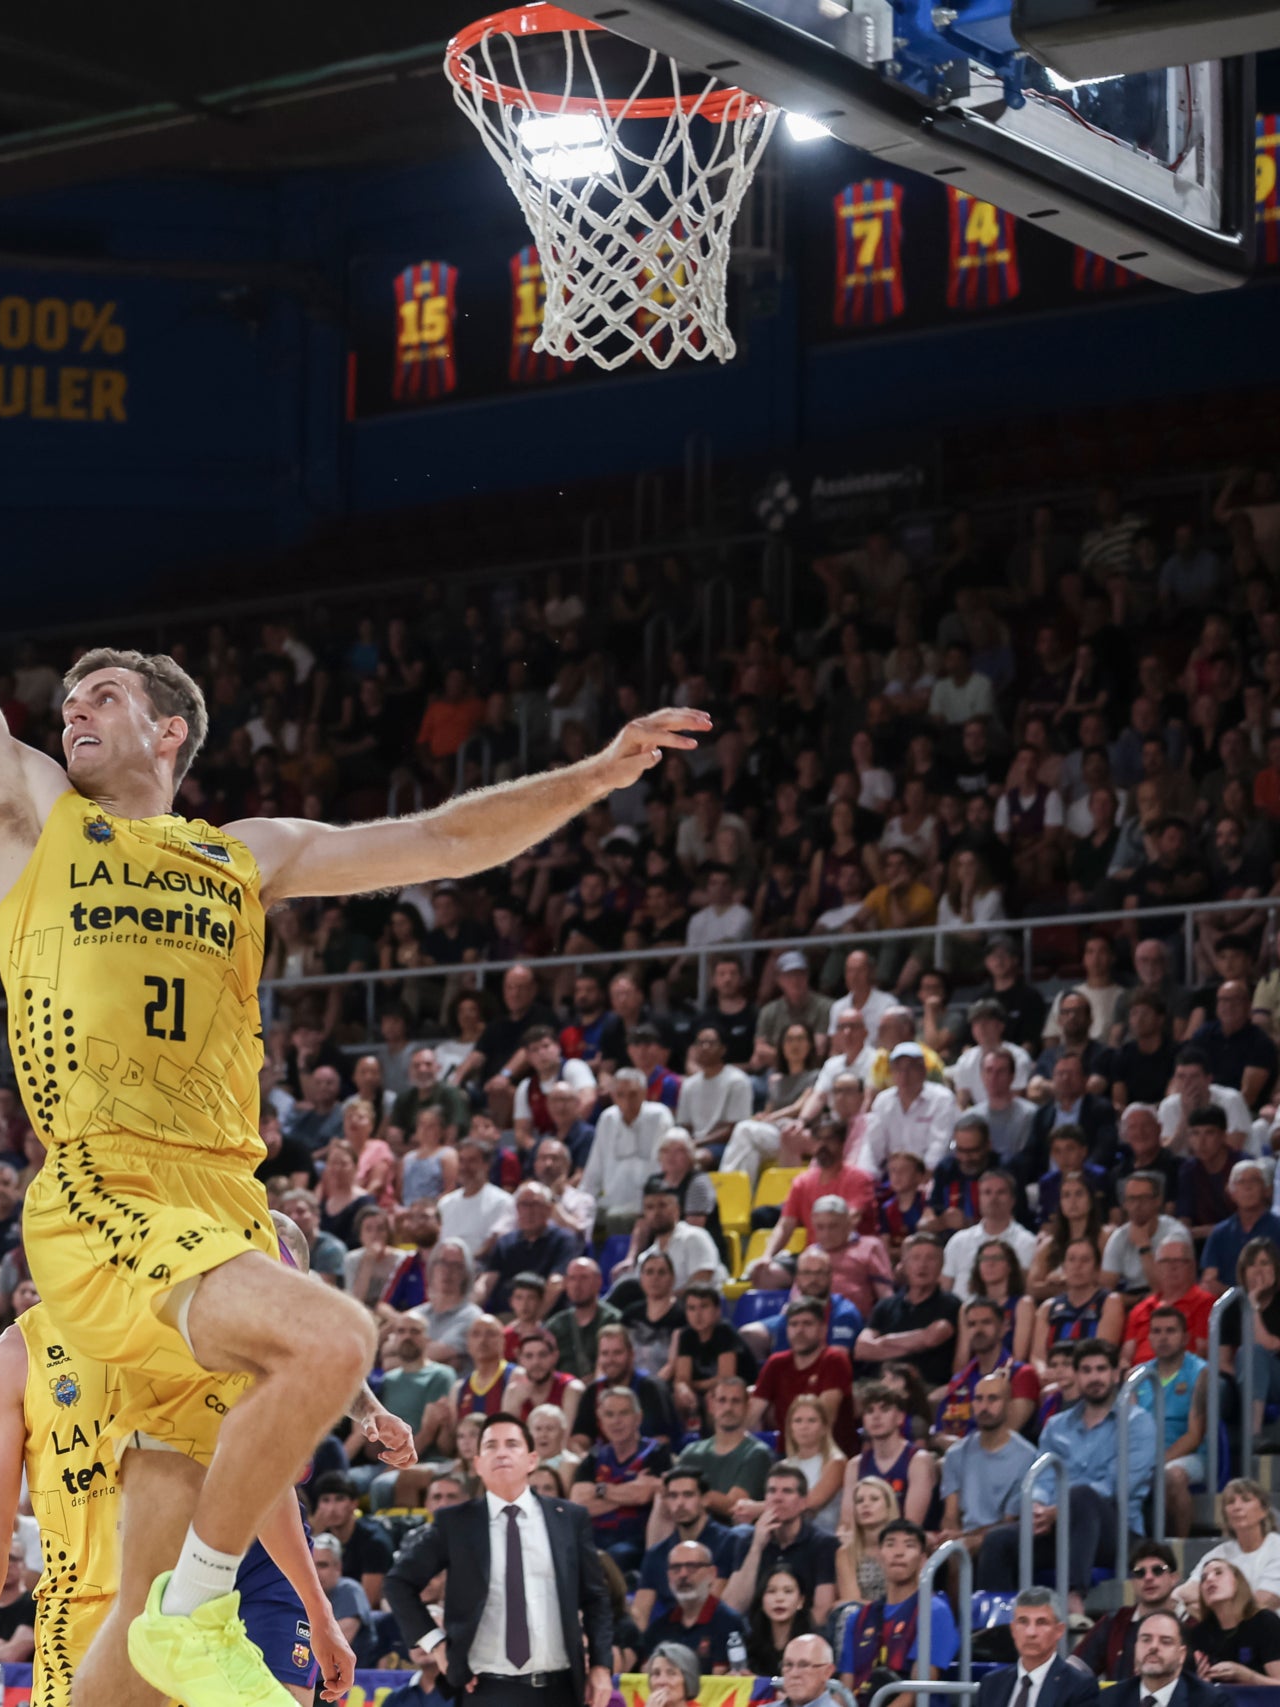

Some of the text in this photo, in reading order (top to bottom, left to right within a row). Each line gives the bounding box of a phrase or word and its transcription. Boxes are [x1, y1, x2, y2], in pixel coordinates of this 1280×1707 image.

[852, 218, 883, 267] 7
[965, 201, 1000, 247] 4
[400, 296, 448, 346] 15
[70, 860, 242, 916] LA LAGUNA
[73, 932, 148, 946] despierta
[144, 975, 186, 1042] 21
[51, 1423, 90, 1455] LA
